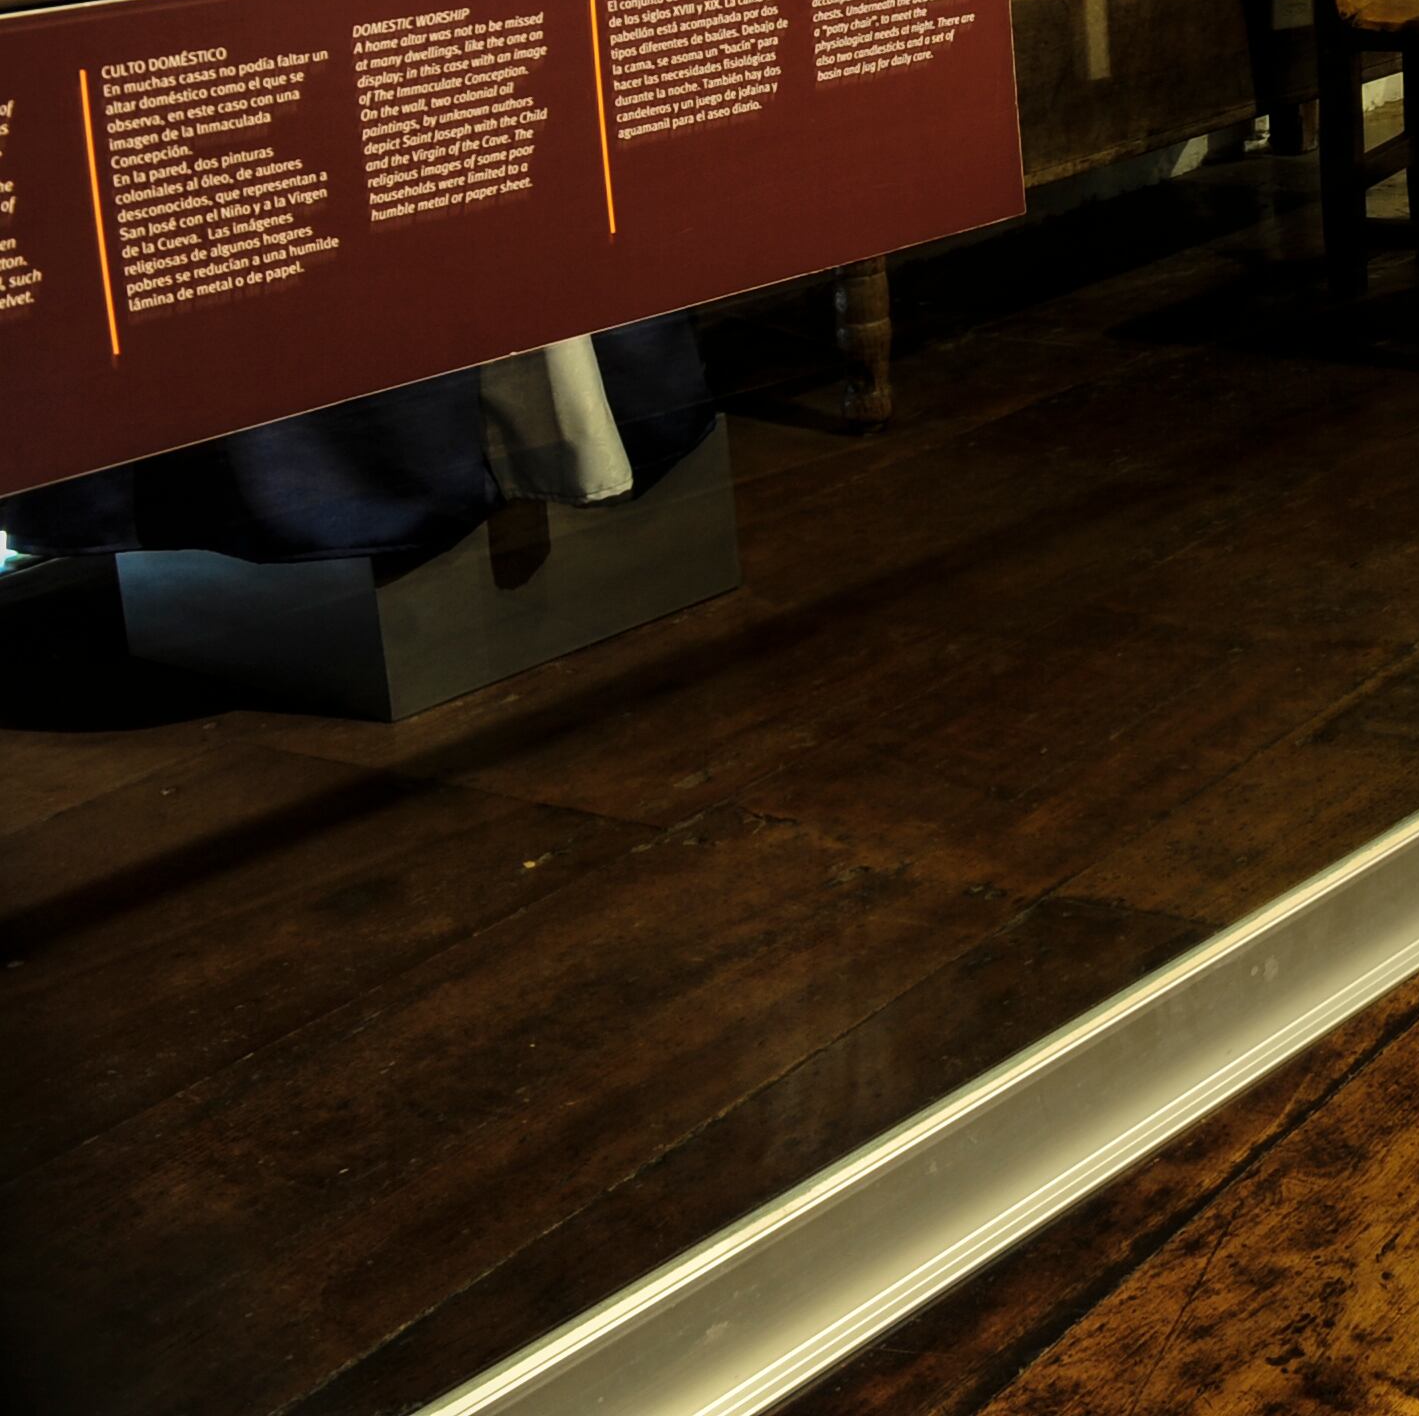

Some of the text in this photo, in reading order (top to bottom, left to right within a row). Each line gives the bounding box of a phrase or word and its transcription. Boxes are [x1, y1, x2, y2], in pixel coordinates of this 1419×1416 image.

[352, 8, 470, 37] DOMESTIC WORSHIP
[607, 0, 617, 12] El
[608, 16, 622, 27] de
[624, 14, 640, 25] los
[641, 8, 671, 23] siglos
[672, 3, 695, 16] XVIII
[696, 4, 702, 15] y
[353, 11, 543, 54] A home altar was not to be missed
[355, 59, 368, 71] at
[370, 55, 402, 68] many
[464, 39, 484, 52] like
[486, 36, 504, 48] the
[506, 33, 527, 45] one
[529, 30, 543, 41] on
[101, 47, 227, 79] CULTO DOMÉSTICO
[103, 50, 328, 97] En muchas casas no podía faltar un
[406, 67, 417, 79] in
[420, 63, 441, 77] this
[443, 59, 469, 72] case
[471, 53, 495, 67] with
[497, 52, 511, 63] an
[513, 46, 547, 59] image
[105, 72, 304, 115] altar doméstico como el que se
[167, 111, 184, 122] en
[187, 105, 215, 118] este
[217, 99, 248, 113] caso
[250, 94, 273, 107] con
[276, 90, 300, 102] una
[358, 91, 372, 106] of
[373, 89, 394, 101] The
[396, 77, 462, 97] Immaculate
[360, 108, 378, 121] On
[380, 105, 399, 117] the
[431, 96, 451, 108] two
[453, 84, 497, 103] colonial
[499, 81, 514, 95] oil
[109, 111, 271, 150] imagen de la Inmaculada
[364, 108, 547, 154] depict Saint Joseph with the Child
[423, 115, 437, 127] by
[439, 105, 489, 123] unknown
[491, 97, 533, 113] authors
[113, 174, 130, 187] En
[133, 170, 146, 183] la
[194, 158, 218, 171] dos
[221, 147, 274, 168] pinturas
[115, 182, 183, 204] coloniales
[186, 177, 198, 190] al
[236, 167, 252, 180] de
[255, 159, 302, 176] autores
[1, 196, 16, 214] of
[215, 189, 240, 204] que
[243, 173, 316, 197] representan
[319, 171, 327, 181] a
[119, 188, 327, 240] San José con el Niño y a la Virgen
[122, 245, 139, 258] de
[142, 242, 155, 253] la
[207, 226, 230, 239] Las
[232, 213, 293, 234] imágenes
[124, 226, 313, 275] religiosas de algunos hogares
[9, 269, 42, 288] such
[126, 236, 339, 296] pobres se reducían a una humilde
[128, 293, 174, 311] lámina
[177, 287, 193, 300] de
[196, 276, 233, 295] metal
[235, 277, 244, 286] o
[246, 271, 262, 284] de
